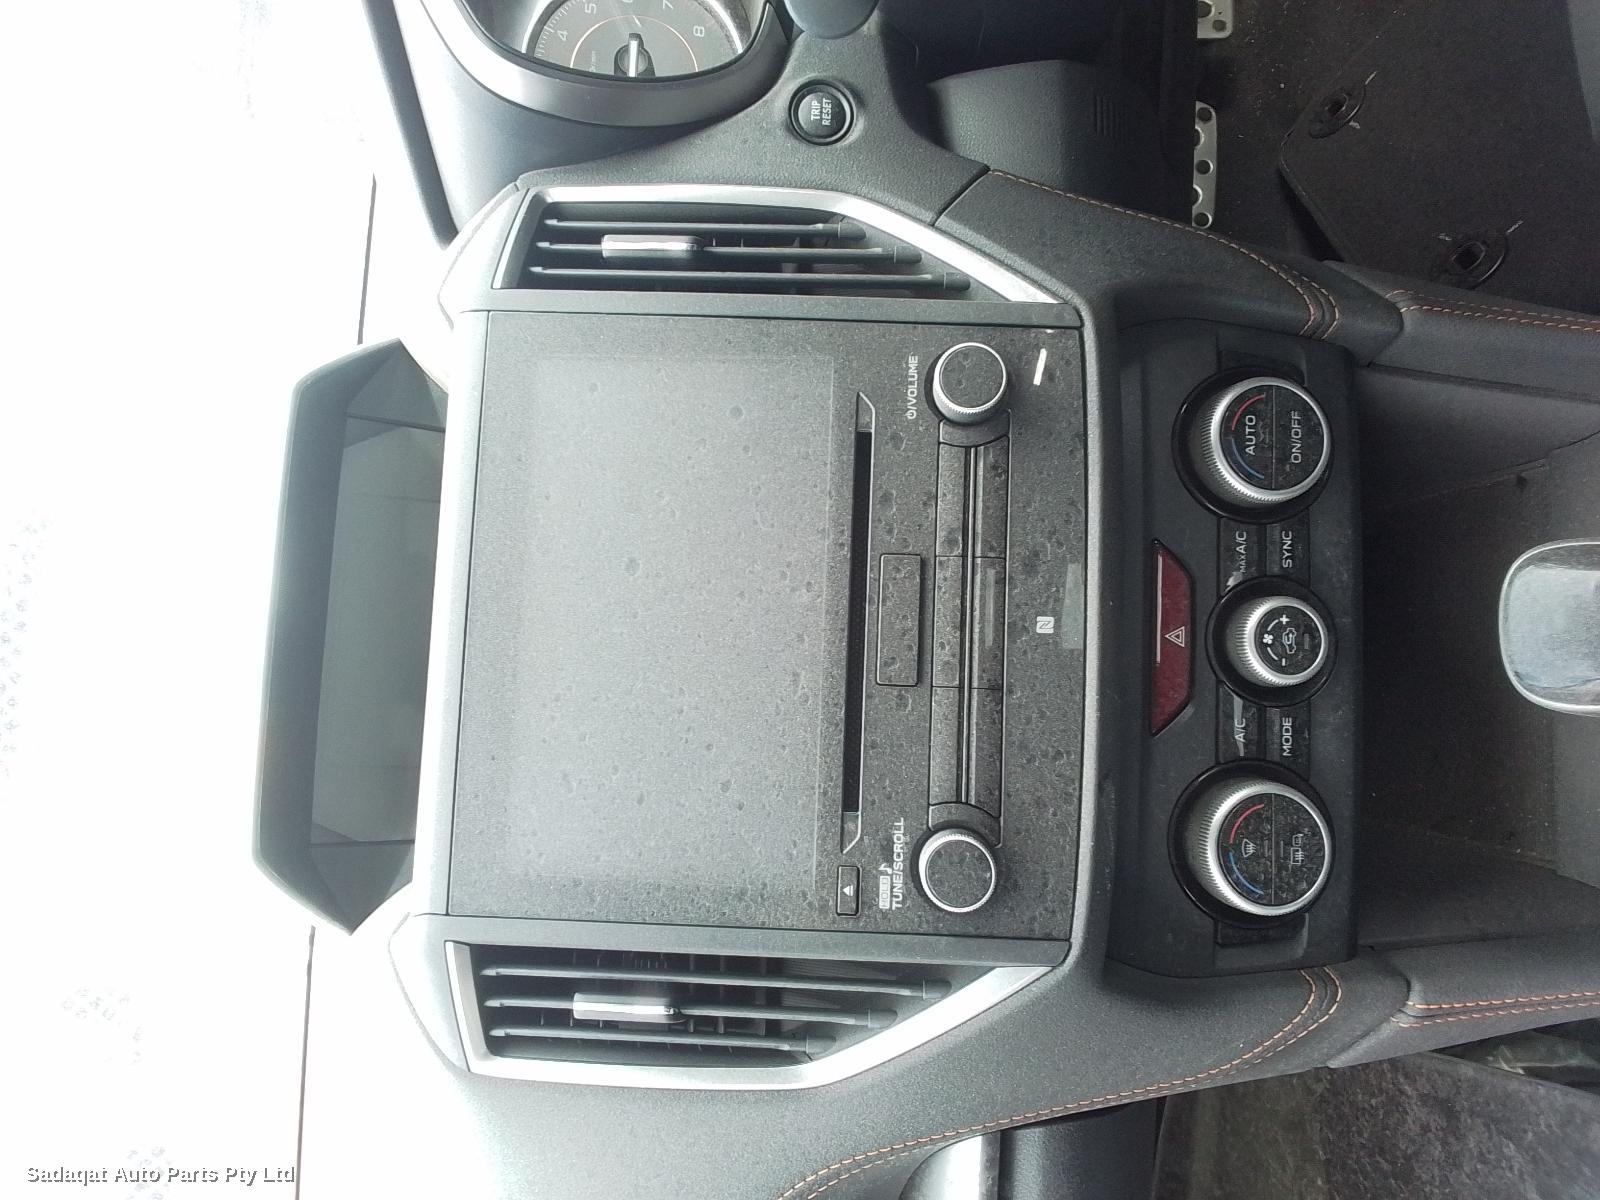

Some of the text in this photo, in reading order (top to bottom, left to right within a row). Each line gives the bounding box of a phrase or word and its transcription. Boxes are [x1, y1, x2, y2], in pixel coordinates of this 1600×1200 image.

[584, 2, 597, 15] 5
[556, 29, 569, 42] 4
[692, 25, 705, 38] 8
[811, 100, 821, 121] TRIP
[822, 97, 832, 126] RESET
[1245, 414, 1256, 456] AUTO
[1291, 410, 1302, 464] ON/OFF
[1281, 530, 1293, 568] SYNC
[1234, 717, 1246, 743] A/C
[1282, 716, 1293, 757] MODE
[891, 817, 905, 910] TUNE/SCROLL
